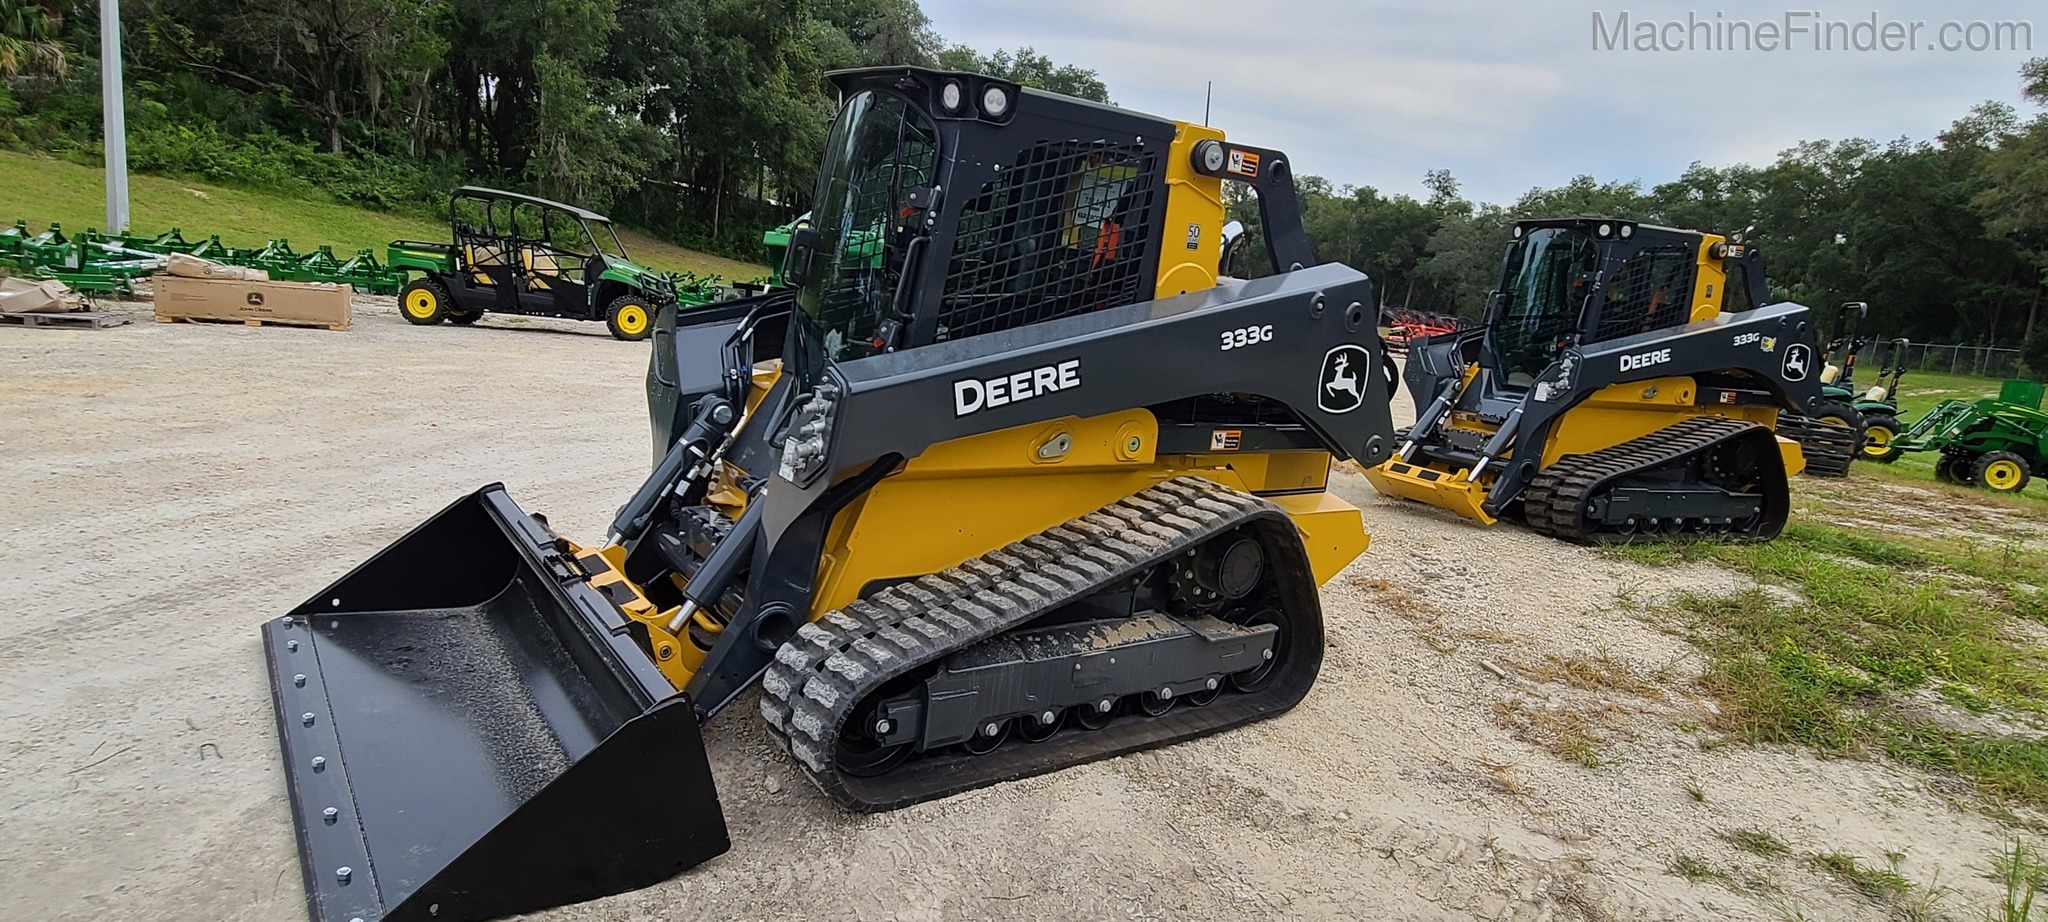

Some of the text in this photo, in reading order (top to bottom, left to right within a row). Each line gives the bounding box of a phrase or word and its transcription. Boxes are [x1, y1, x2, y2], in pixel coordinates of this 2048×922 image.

[1188, 225, 1200, 238] 50
[1220, 324, 1273, 351] 333G
[1733, 332, 1760, 346] 333G
[1619, 348, 1671, 372] DEERE
[954, 359, 1080, 416] DEERE
